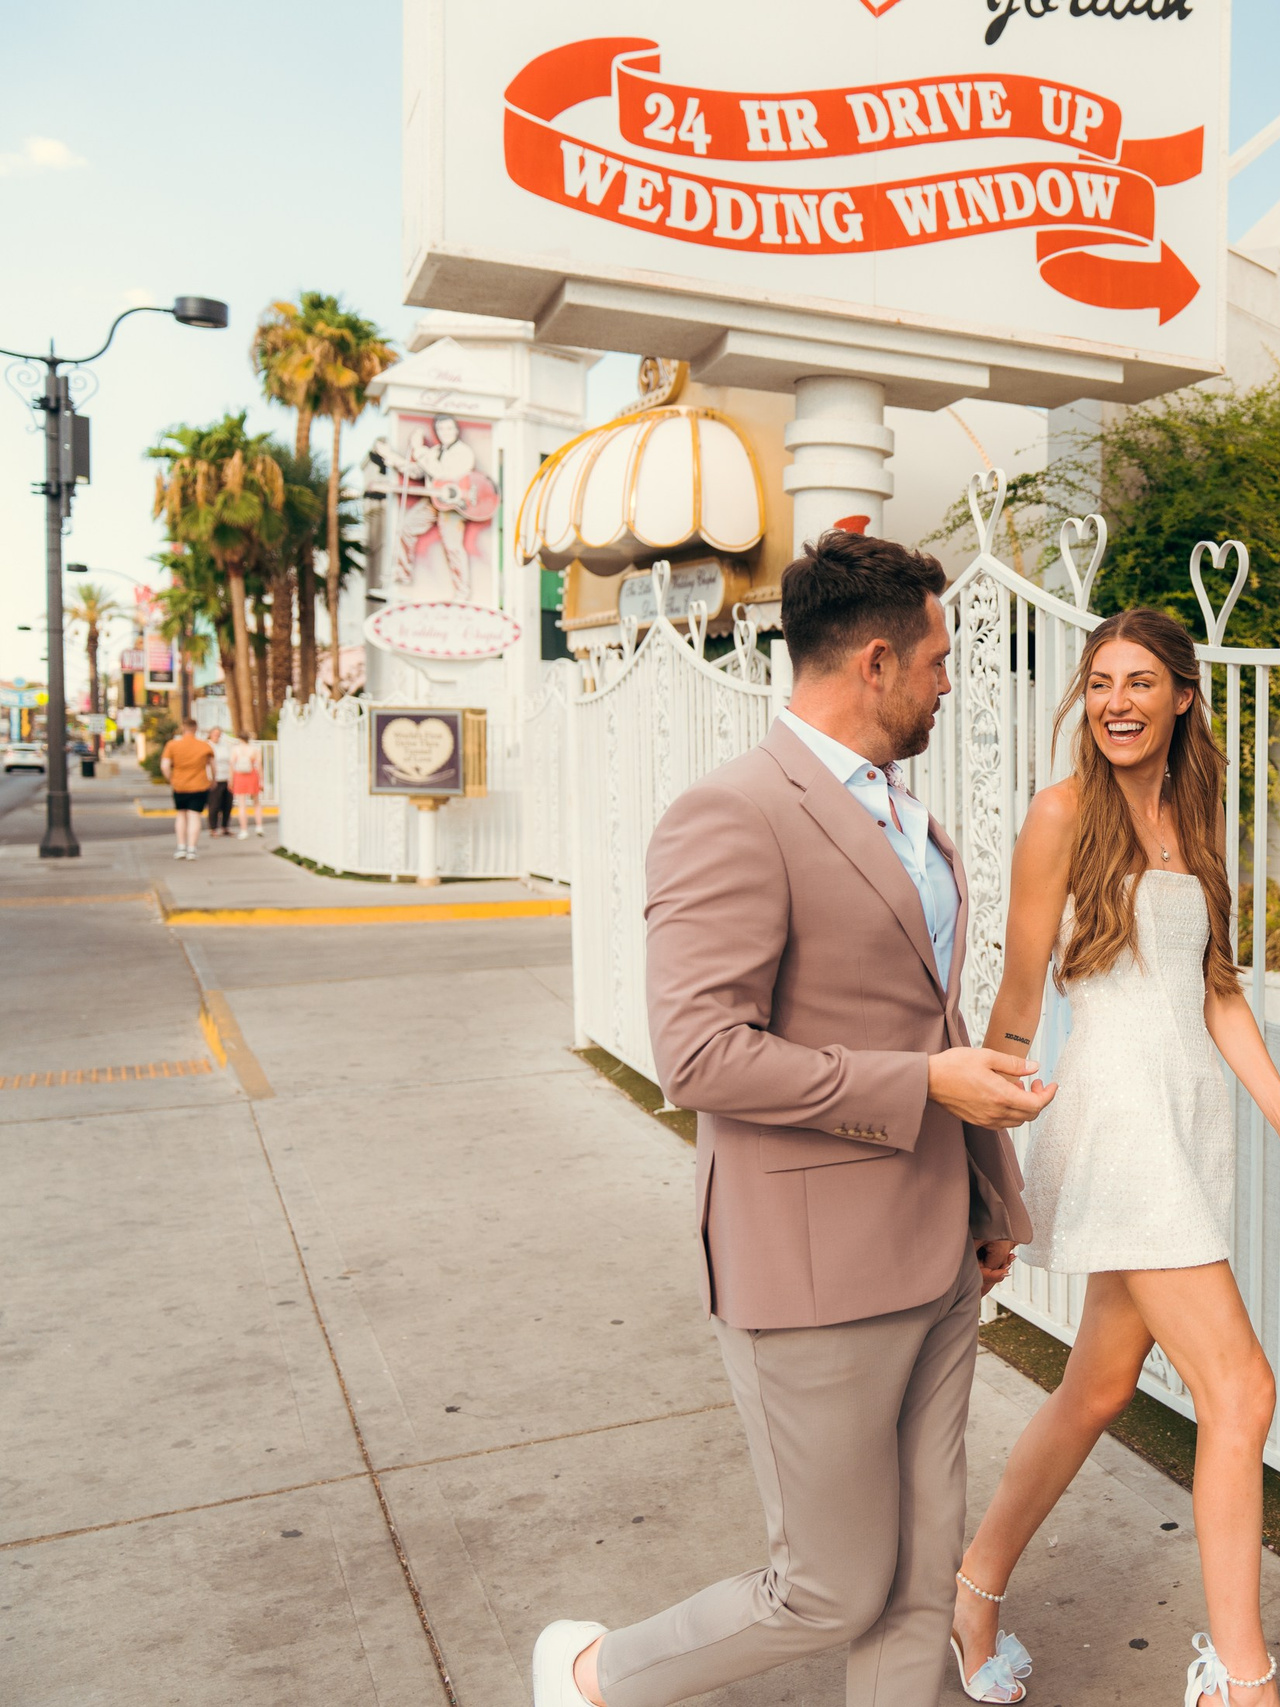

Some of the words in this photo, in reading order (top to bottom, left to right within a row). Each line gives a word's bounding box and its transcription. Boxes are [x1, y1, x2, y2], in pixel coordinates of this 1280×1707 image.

[643, 93, 712, 155] 24
[741, 97, 828, 153] HR
[847, 82, 1011, 145] DRIVE
[1040, 87, 1104, 143] UP
[561, 140, 864, 245] WEDDING
[886, 168, 1120, 237] WINDOW
